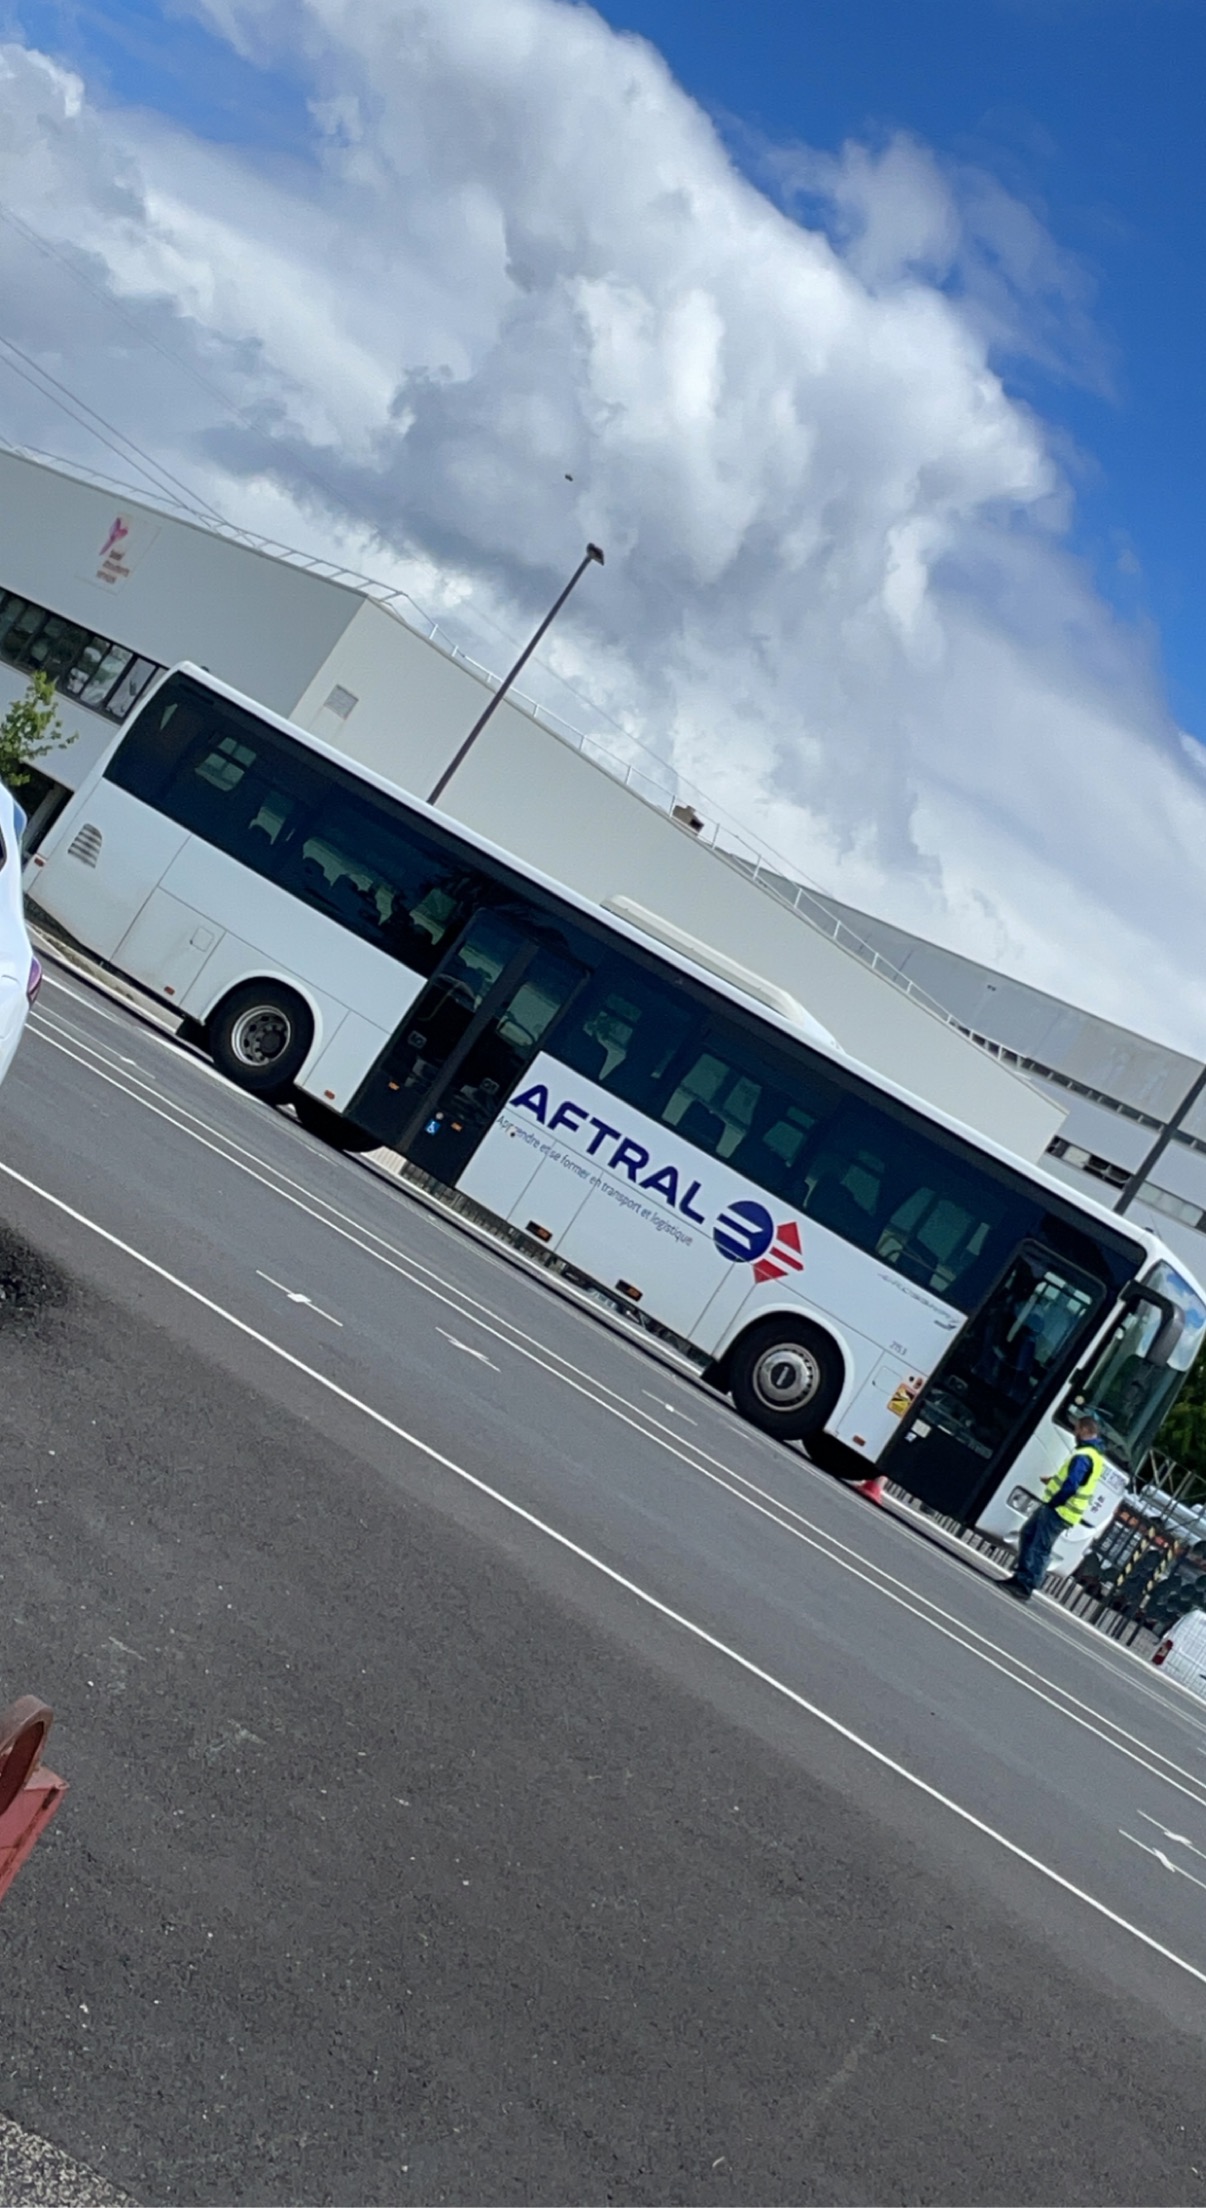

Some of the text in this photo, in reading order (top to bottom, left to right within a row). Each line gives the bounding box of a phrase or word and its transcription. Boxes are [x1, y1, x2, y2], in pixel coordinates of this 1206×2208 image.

[508, 1084, 705, 1225] AFTRAL
[549, 1150, 561, 1161] se
[560, 1154, 591, 1179] former
[588, 1176, 602, 1188] en
[601, 1182, 642, 1214] transport
[640, 1208, 652, 1220] et
[650, 1212, 693, 1246] logistique
